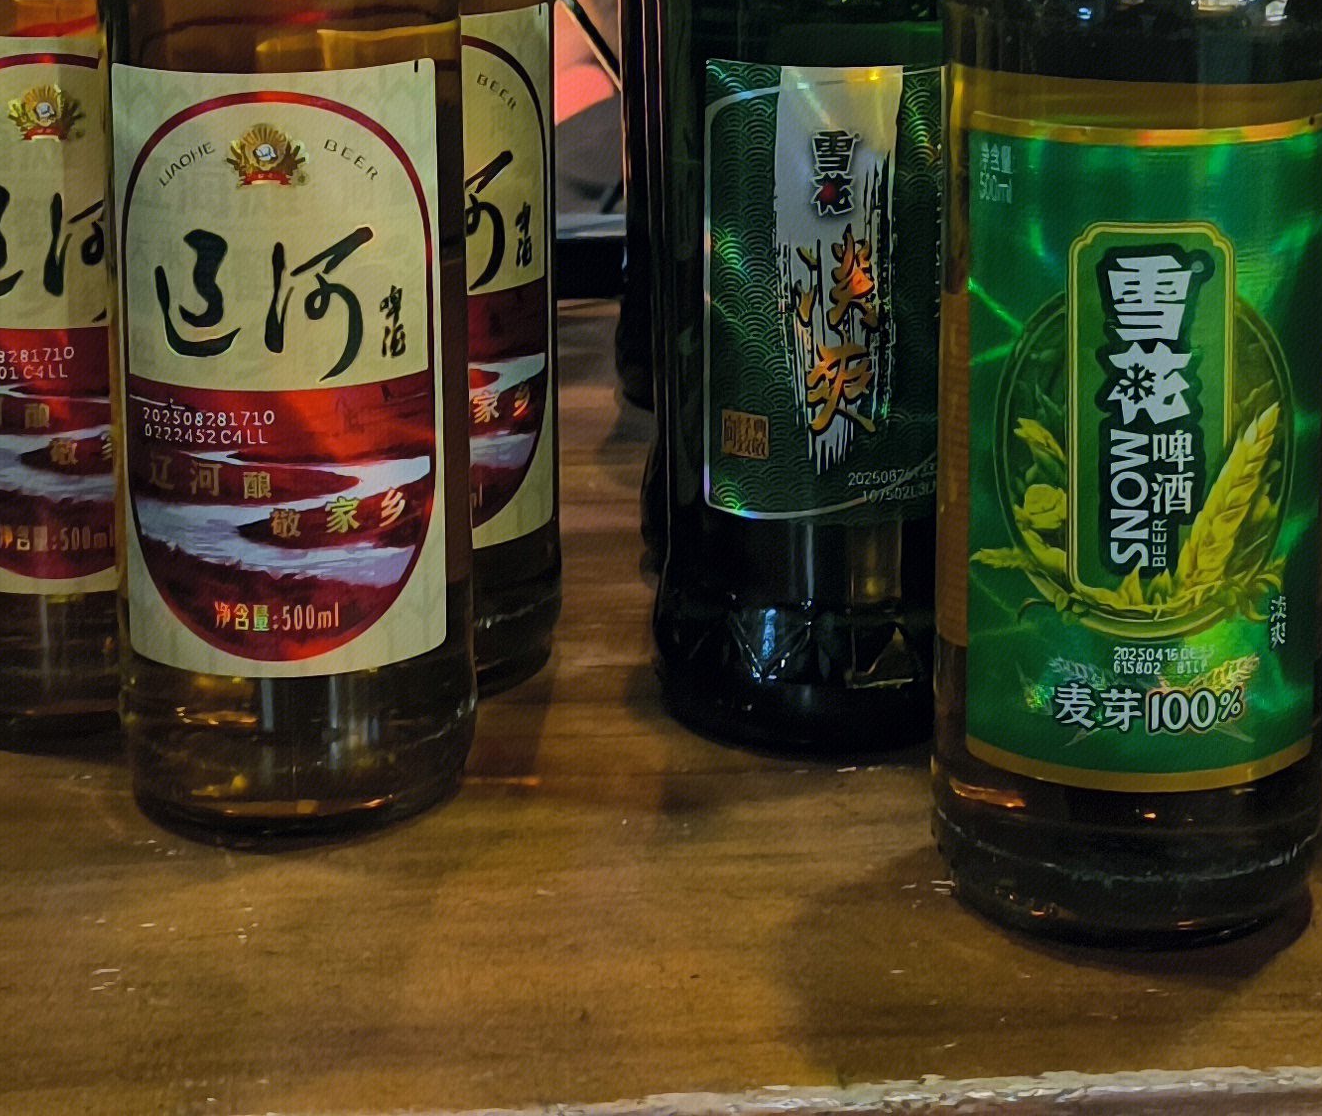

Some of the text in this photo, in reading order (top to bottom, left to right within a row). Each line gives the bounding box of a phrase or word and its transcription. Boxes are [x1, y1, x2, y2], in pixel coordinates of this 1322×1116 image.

[158, 138, 379, 189] LIAOHE BEER
[810, 129, 859, 217] 雪花
[1106, 254, 1193, 425] 雪花
[1109, 428, 1150, 569] SNOW
[1151, 428, 1196, 516] 啤酒
[1152, 518, 1168, 568] BEER
[1053, 682, 1244, 734] 麦芽100%
